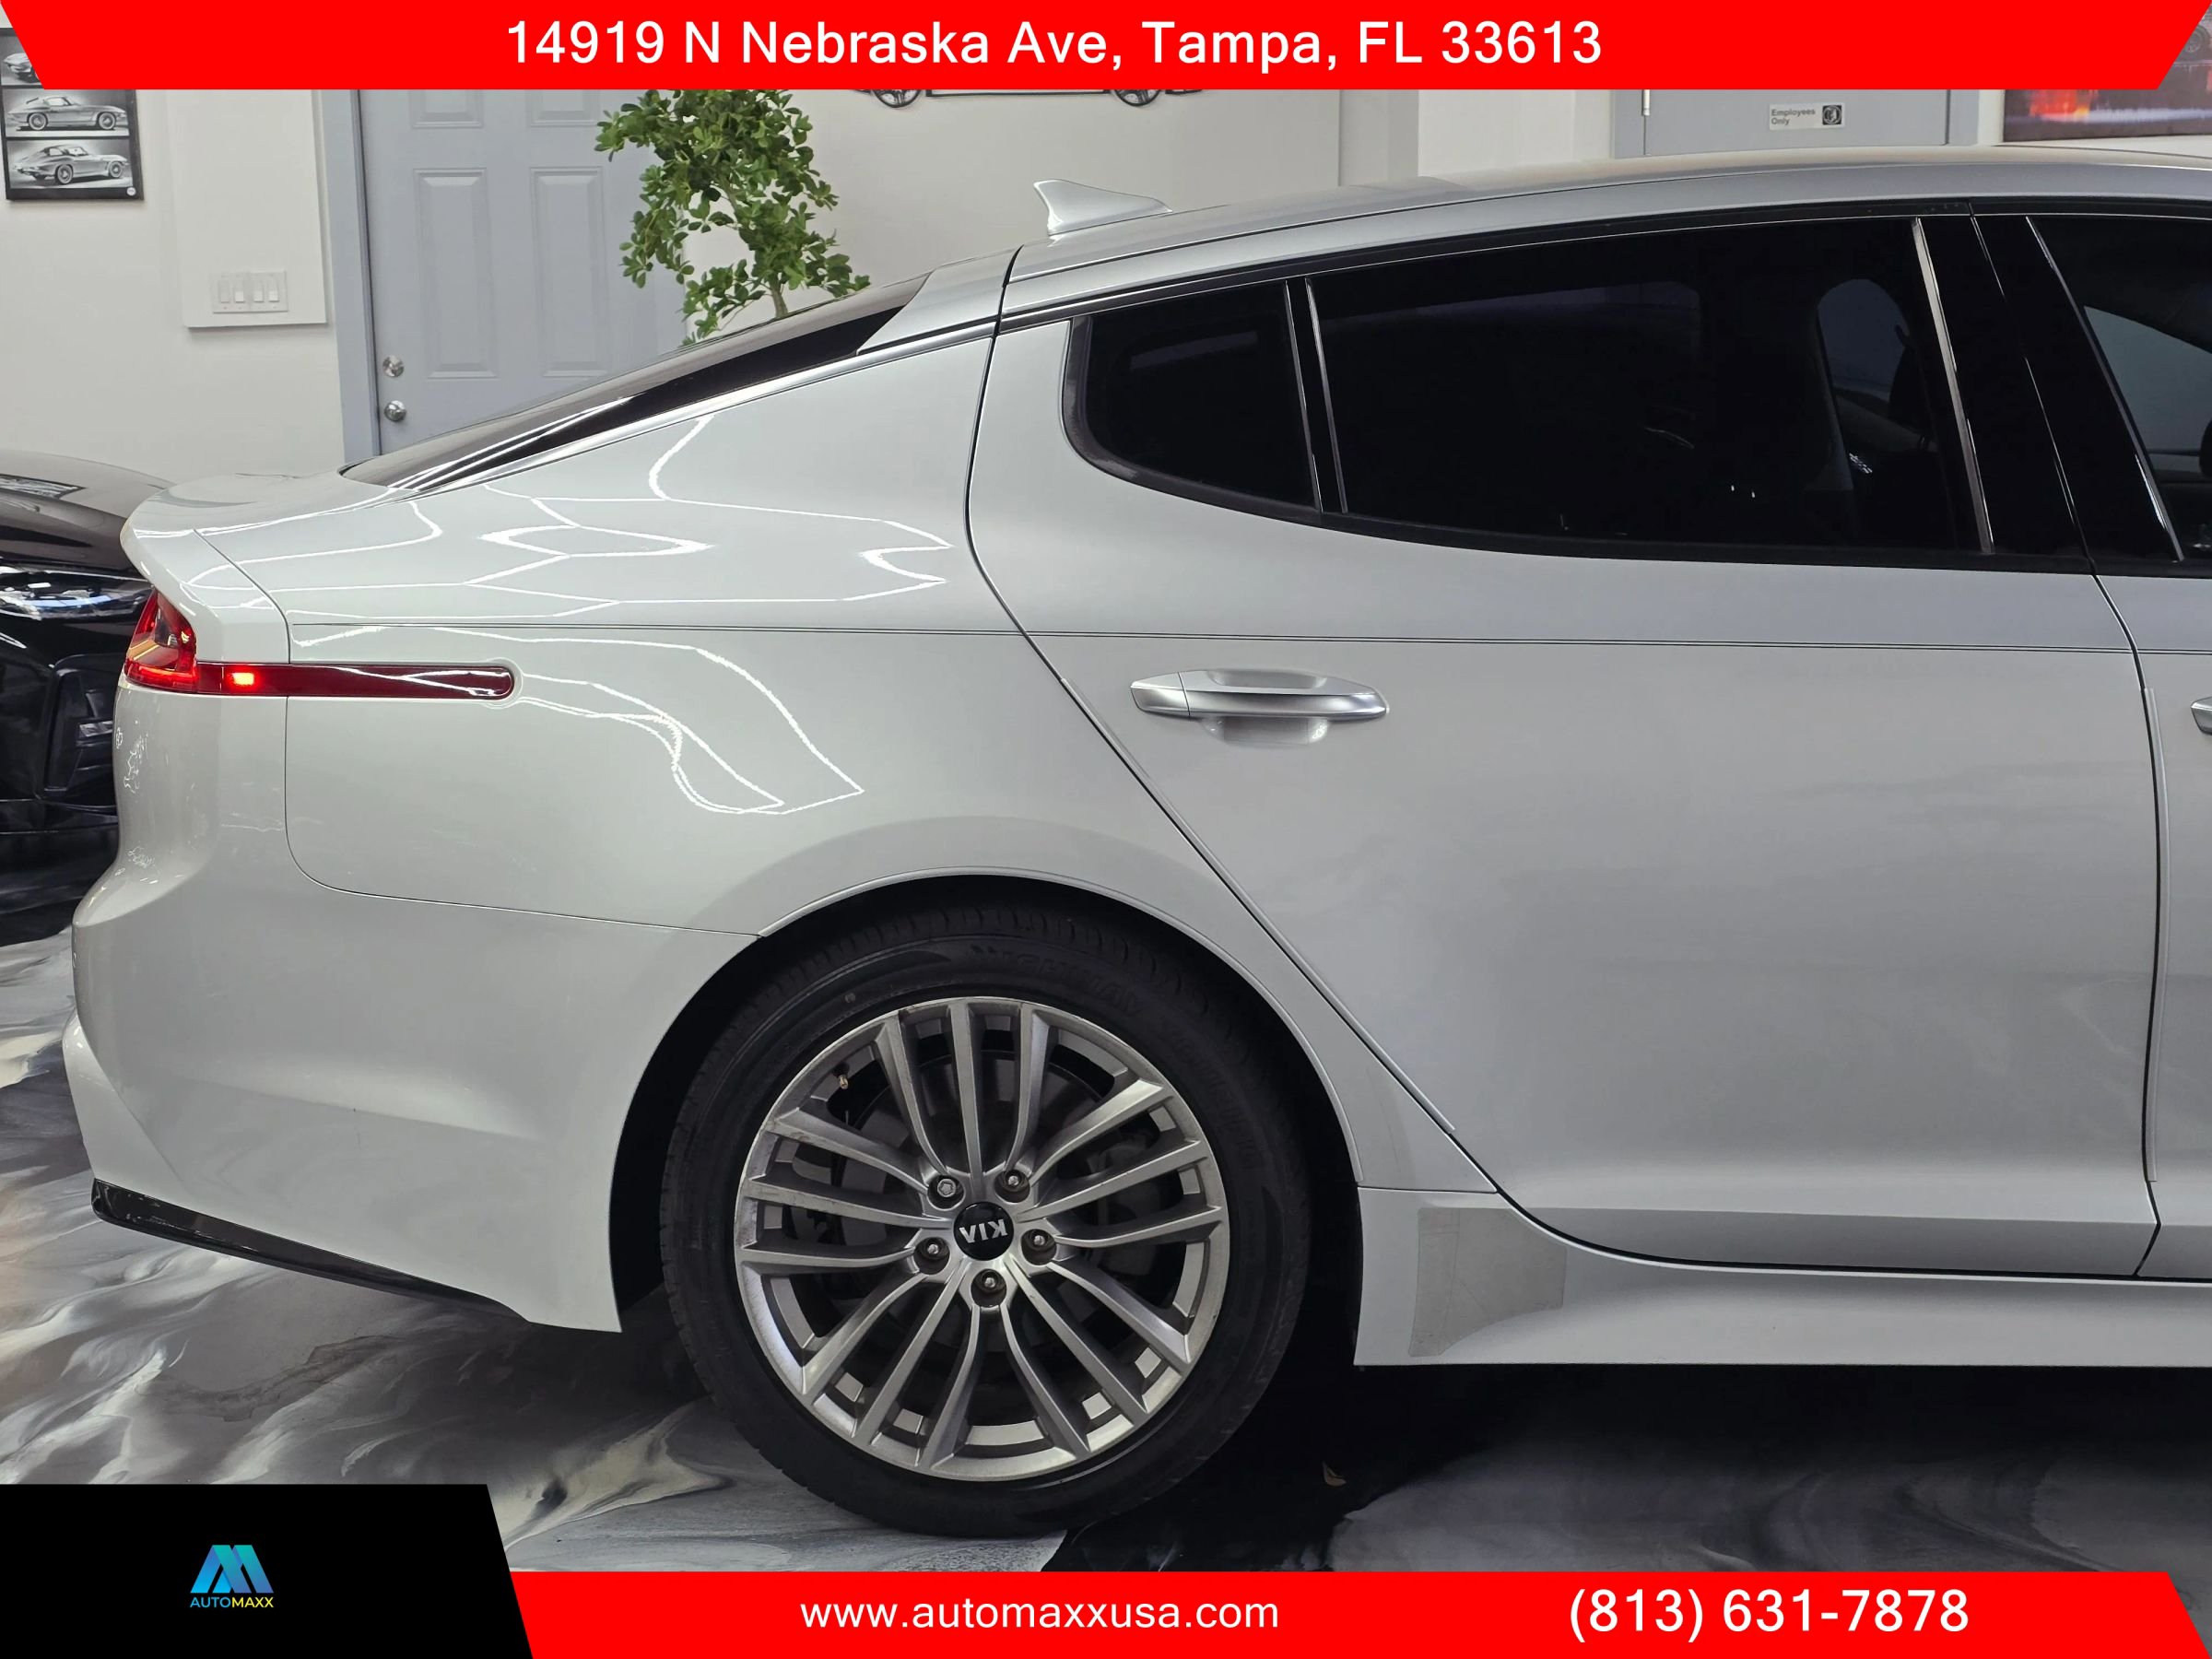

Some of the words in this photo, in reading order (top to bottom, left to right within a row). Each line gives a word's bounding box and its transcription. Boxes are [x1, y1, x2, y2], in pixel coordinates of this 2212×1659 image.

[1771, 108, 1816, 117] Employees
[1771, 117, 1790, 125] Only
[959, 1218, 1008, 1243] KIA
